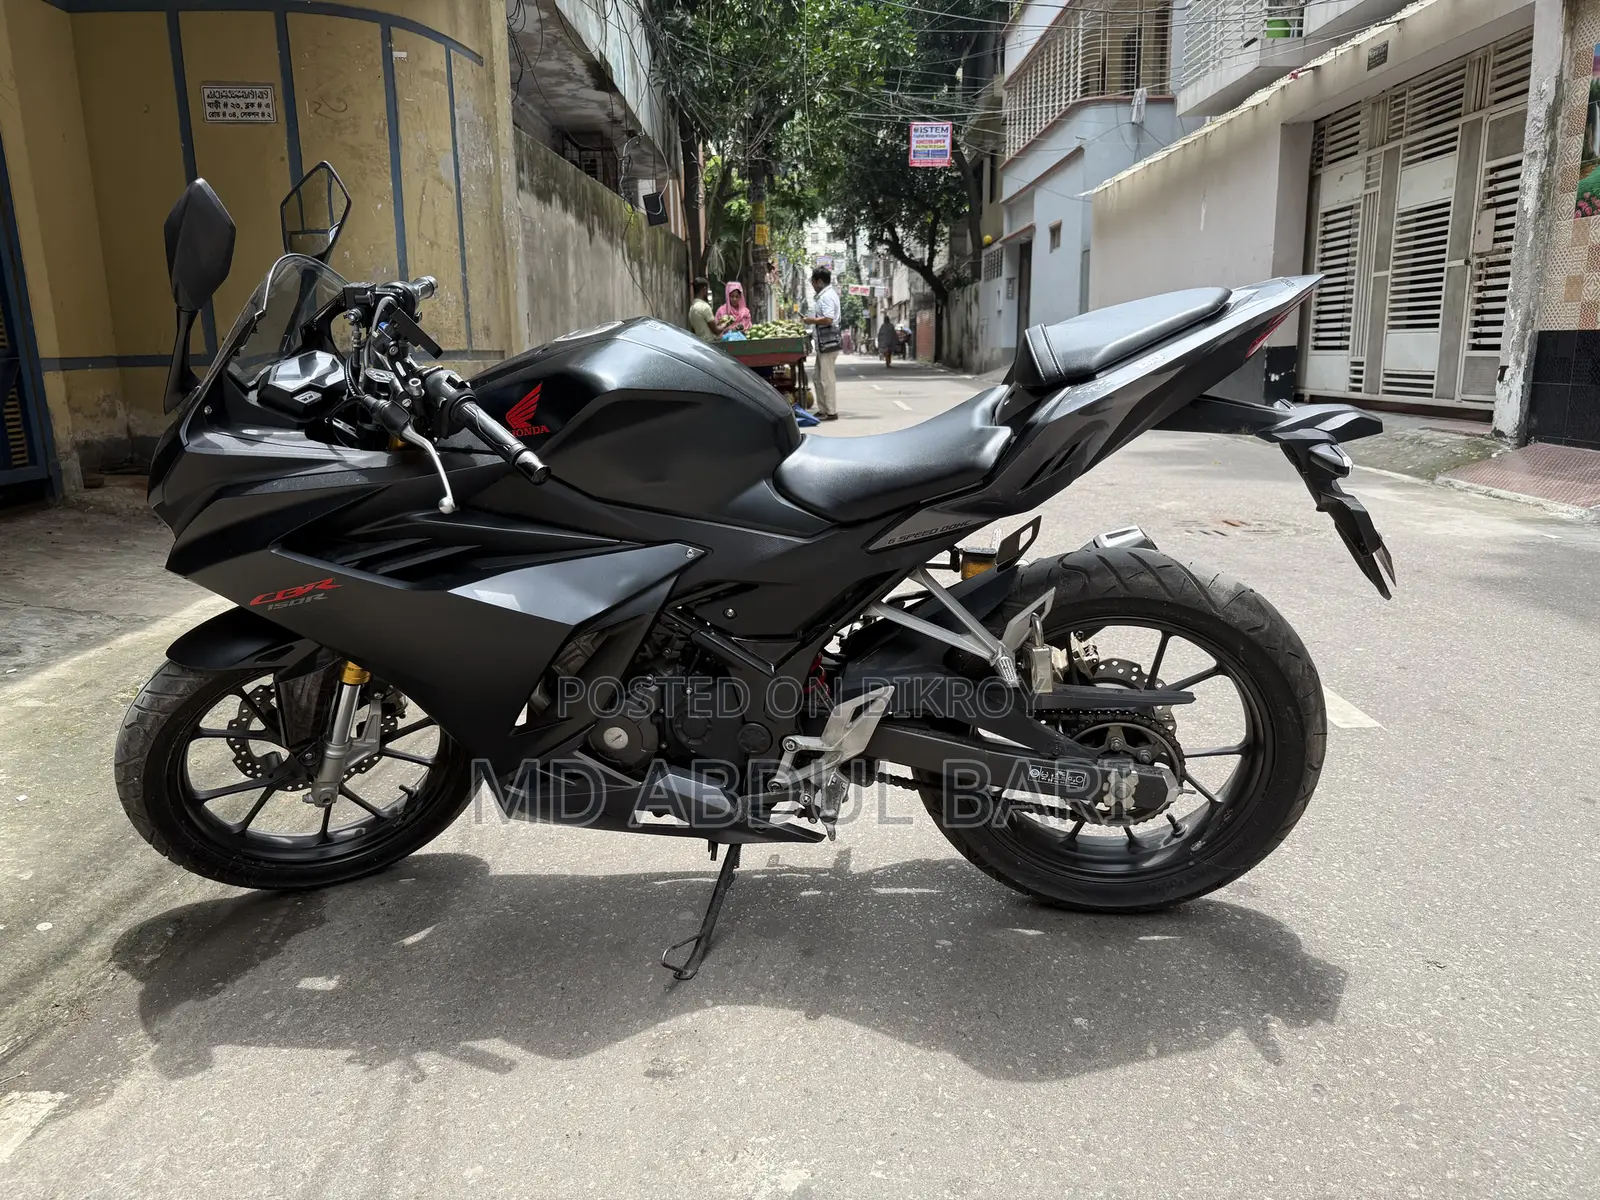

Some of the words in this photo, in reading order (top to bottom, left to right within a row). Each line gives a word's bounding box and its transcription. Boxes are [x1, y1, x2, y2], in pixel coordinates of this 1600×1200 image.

[887, 537, 896, 545] 6
[898, 528, 938, 542] SPEED
[939, 520, 973, 533] DOHC
[250, 578, 343, 606] CBR
[267, 593, 328, 611] 150R
